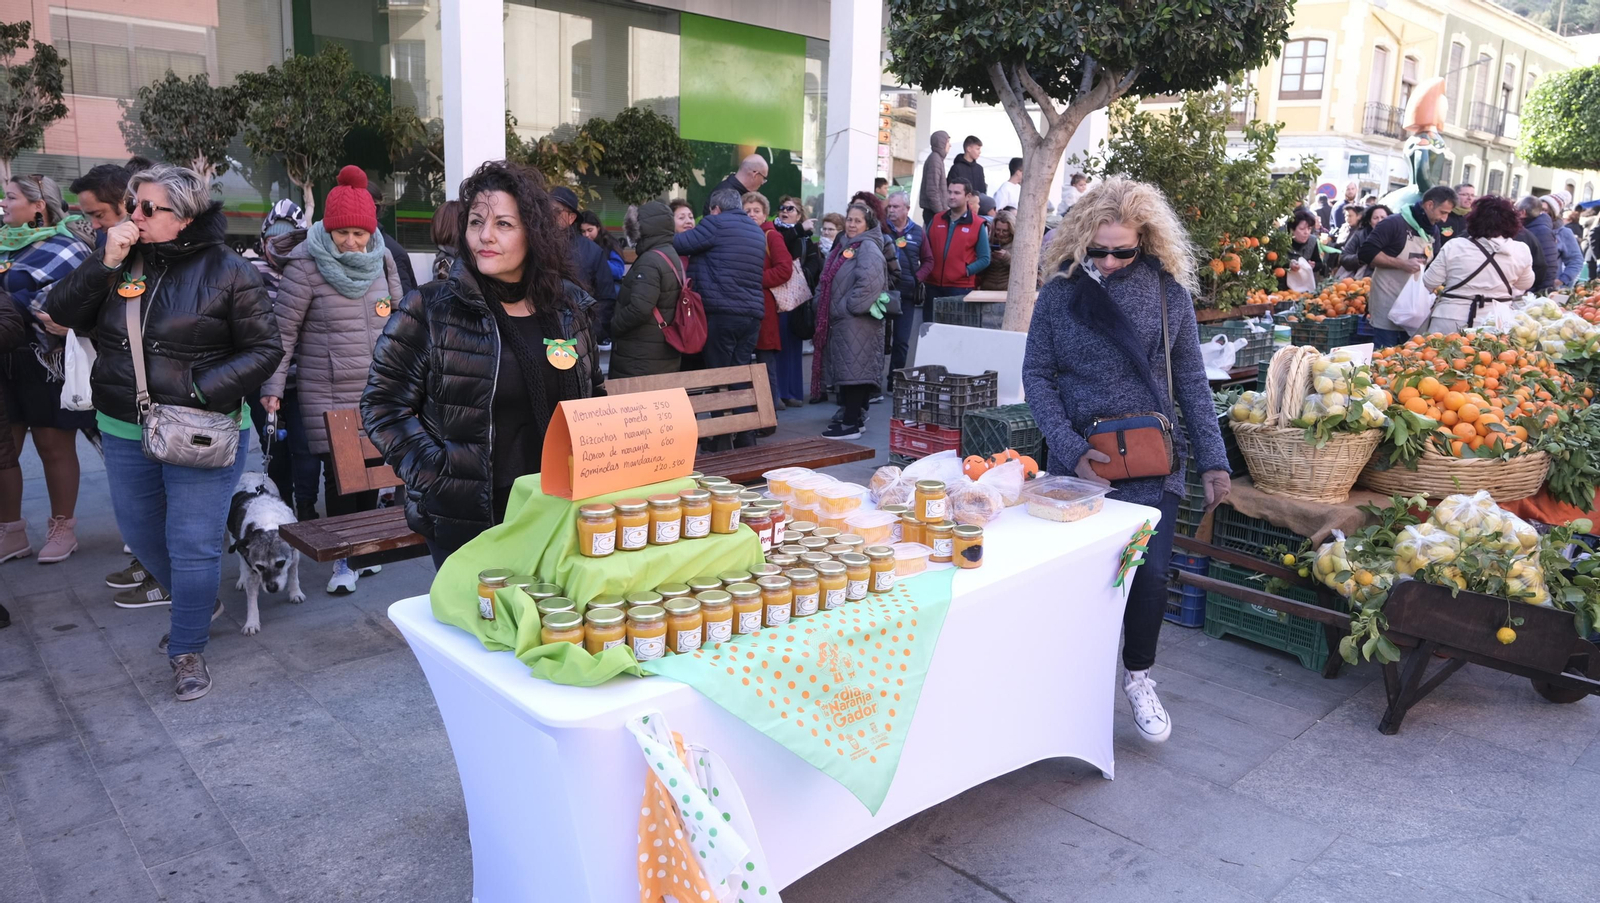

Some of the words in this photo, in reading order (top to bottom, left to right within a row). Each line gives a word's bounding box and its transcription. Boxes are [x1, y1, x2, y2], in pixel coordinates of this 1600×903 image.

[623, 412, 648, 428] pomelo
[623, 427, 653, 440] naranja
[582, 450, 606, 462] Roscos
[609, 446, 617, 458] de
[621, 442, 650, 457] naranja
[828, 692, 872, 714] Naranja
